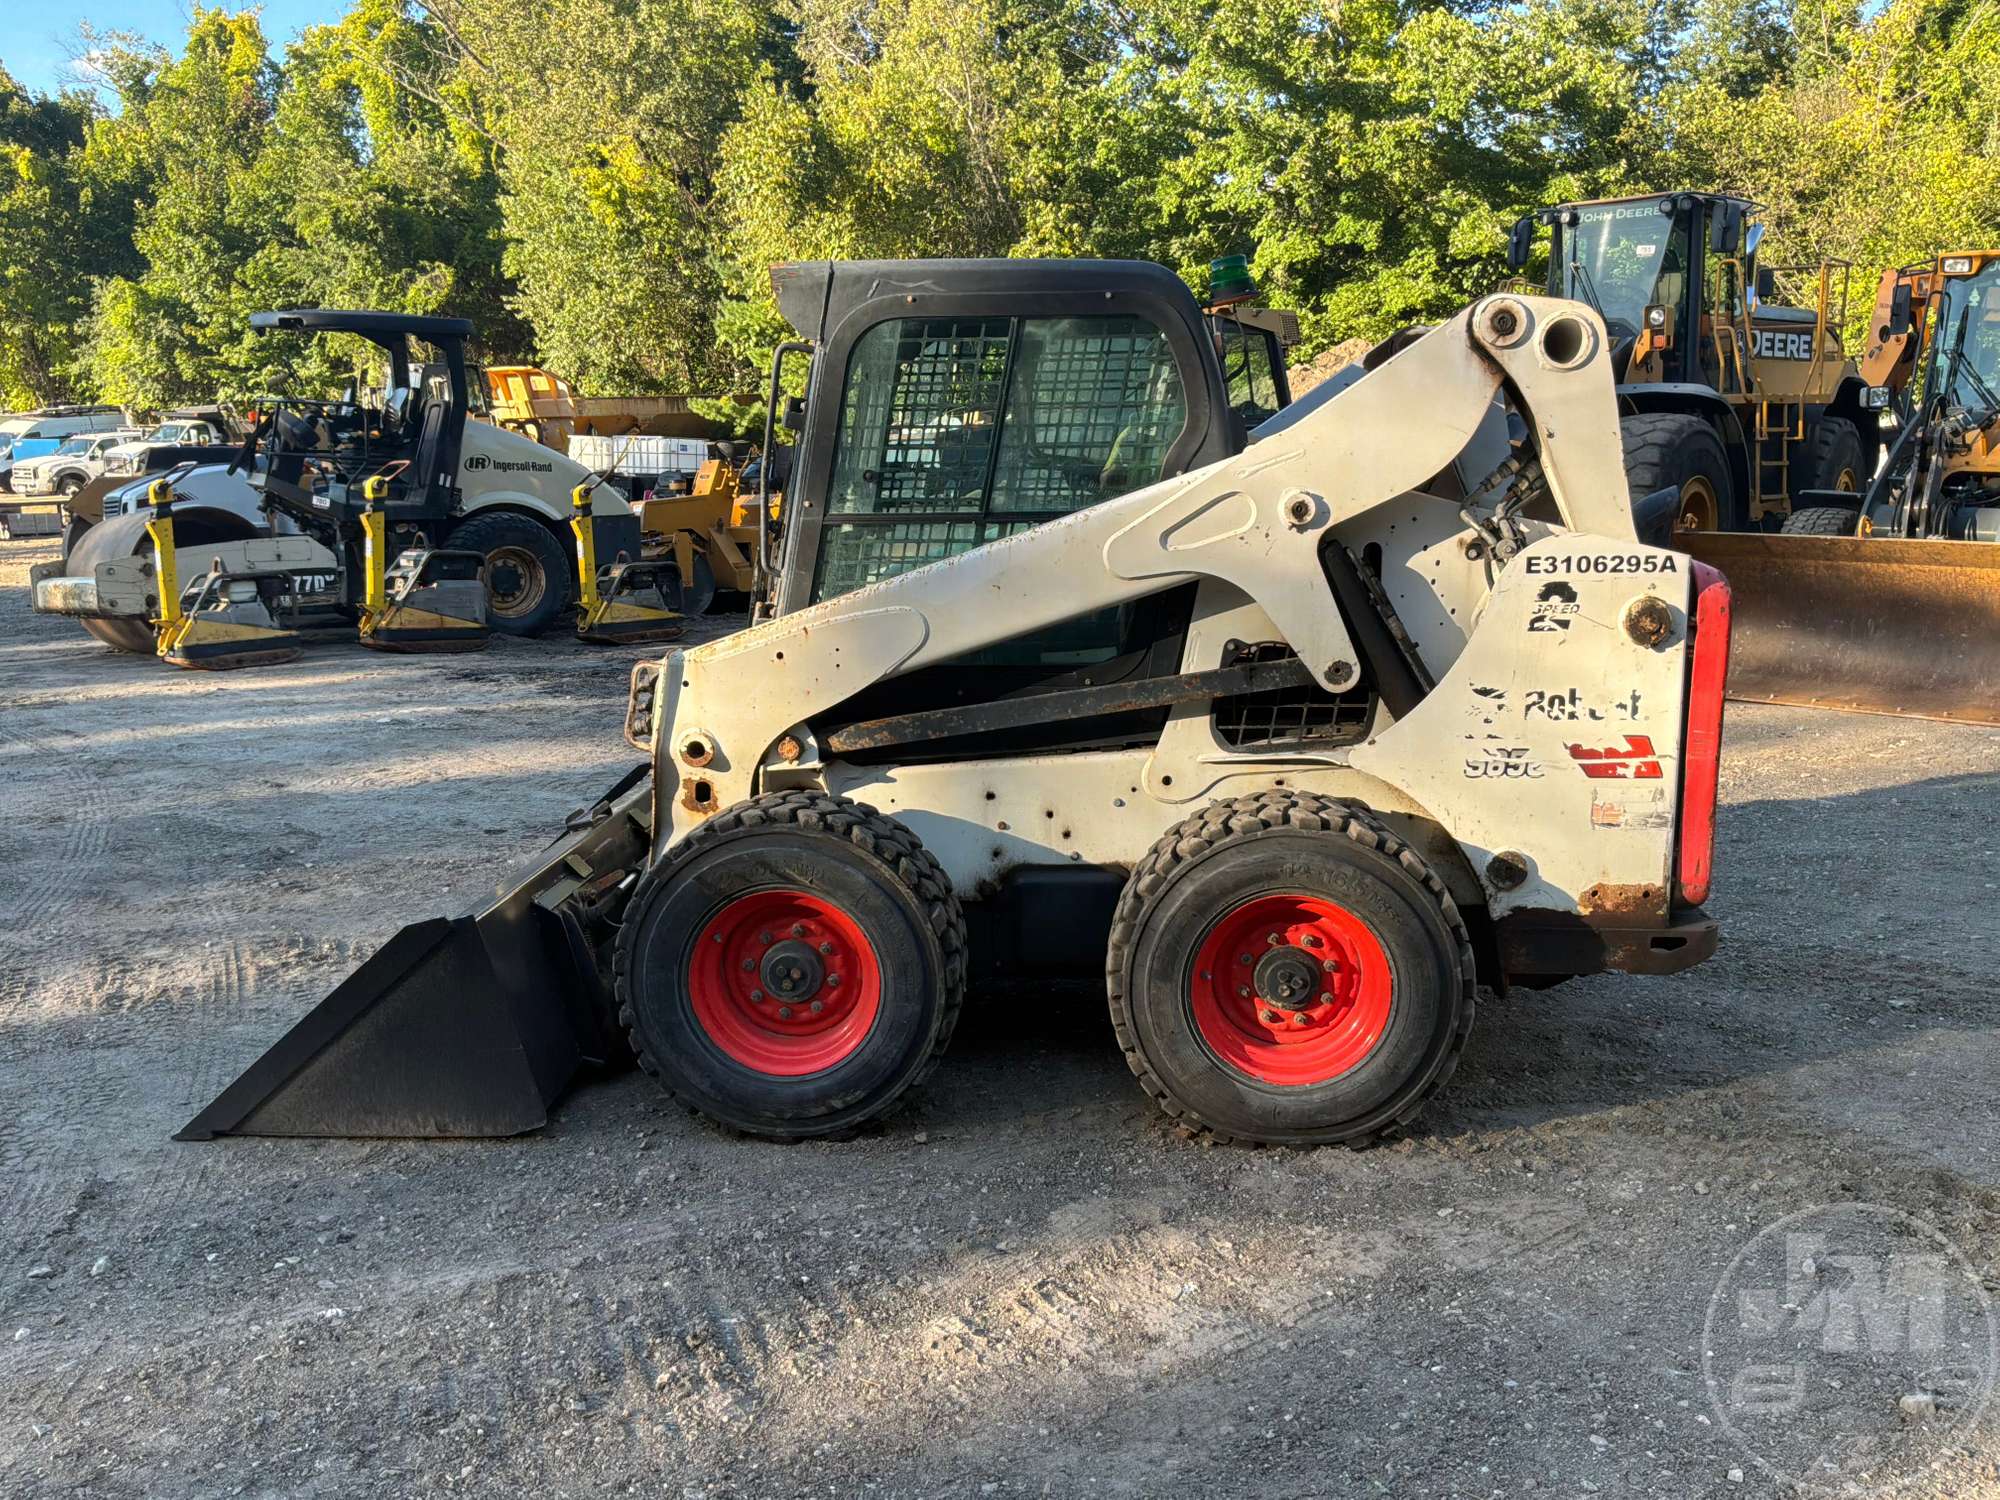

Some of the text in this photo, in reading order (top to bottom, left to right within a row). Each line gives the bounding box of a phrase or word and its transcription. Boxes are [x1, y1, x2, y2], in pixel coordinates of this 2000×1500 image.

[1580, 207, 1662, 223] JOHN DEERE
[1751, 329, 1812, 359] DEERE
[492, 459, 553, 473] Ingersoll-Rand
[1525, 555, 1677, 574] E3106295A
